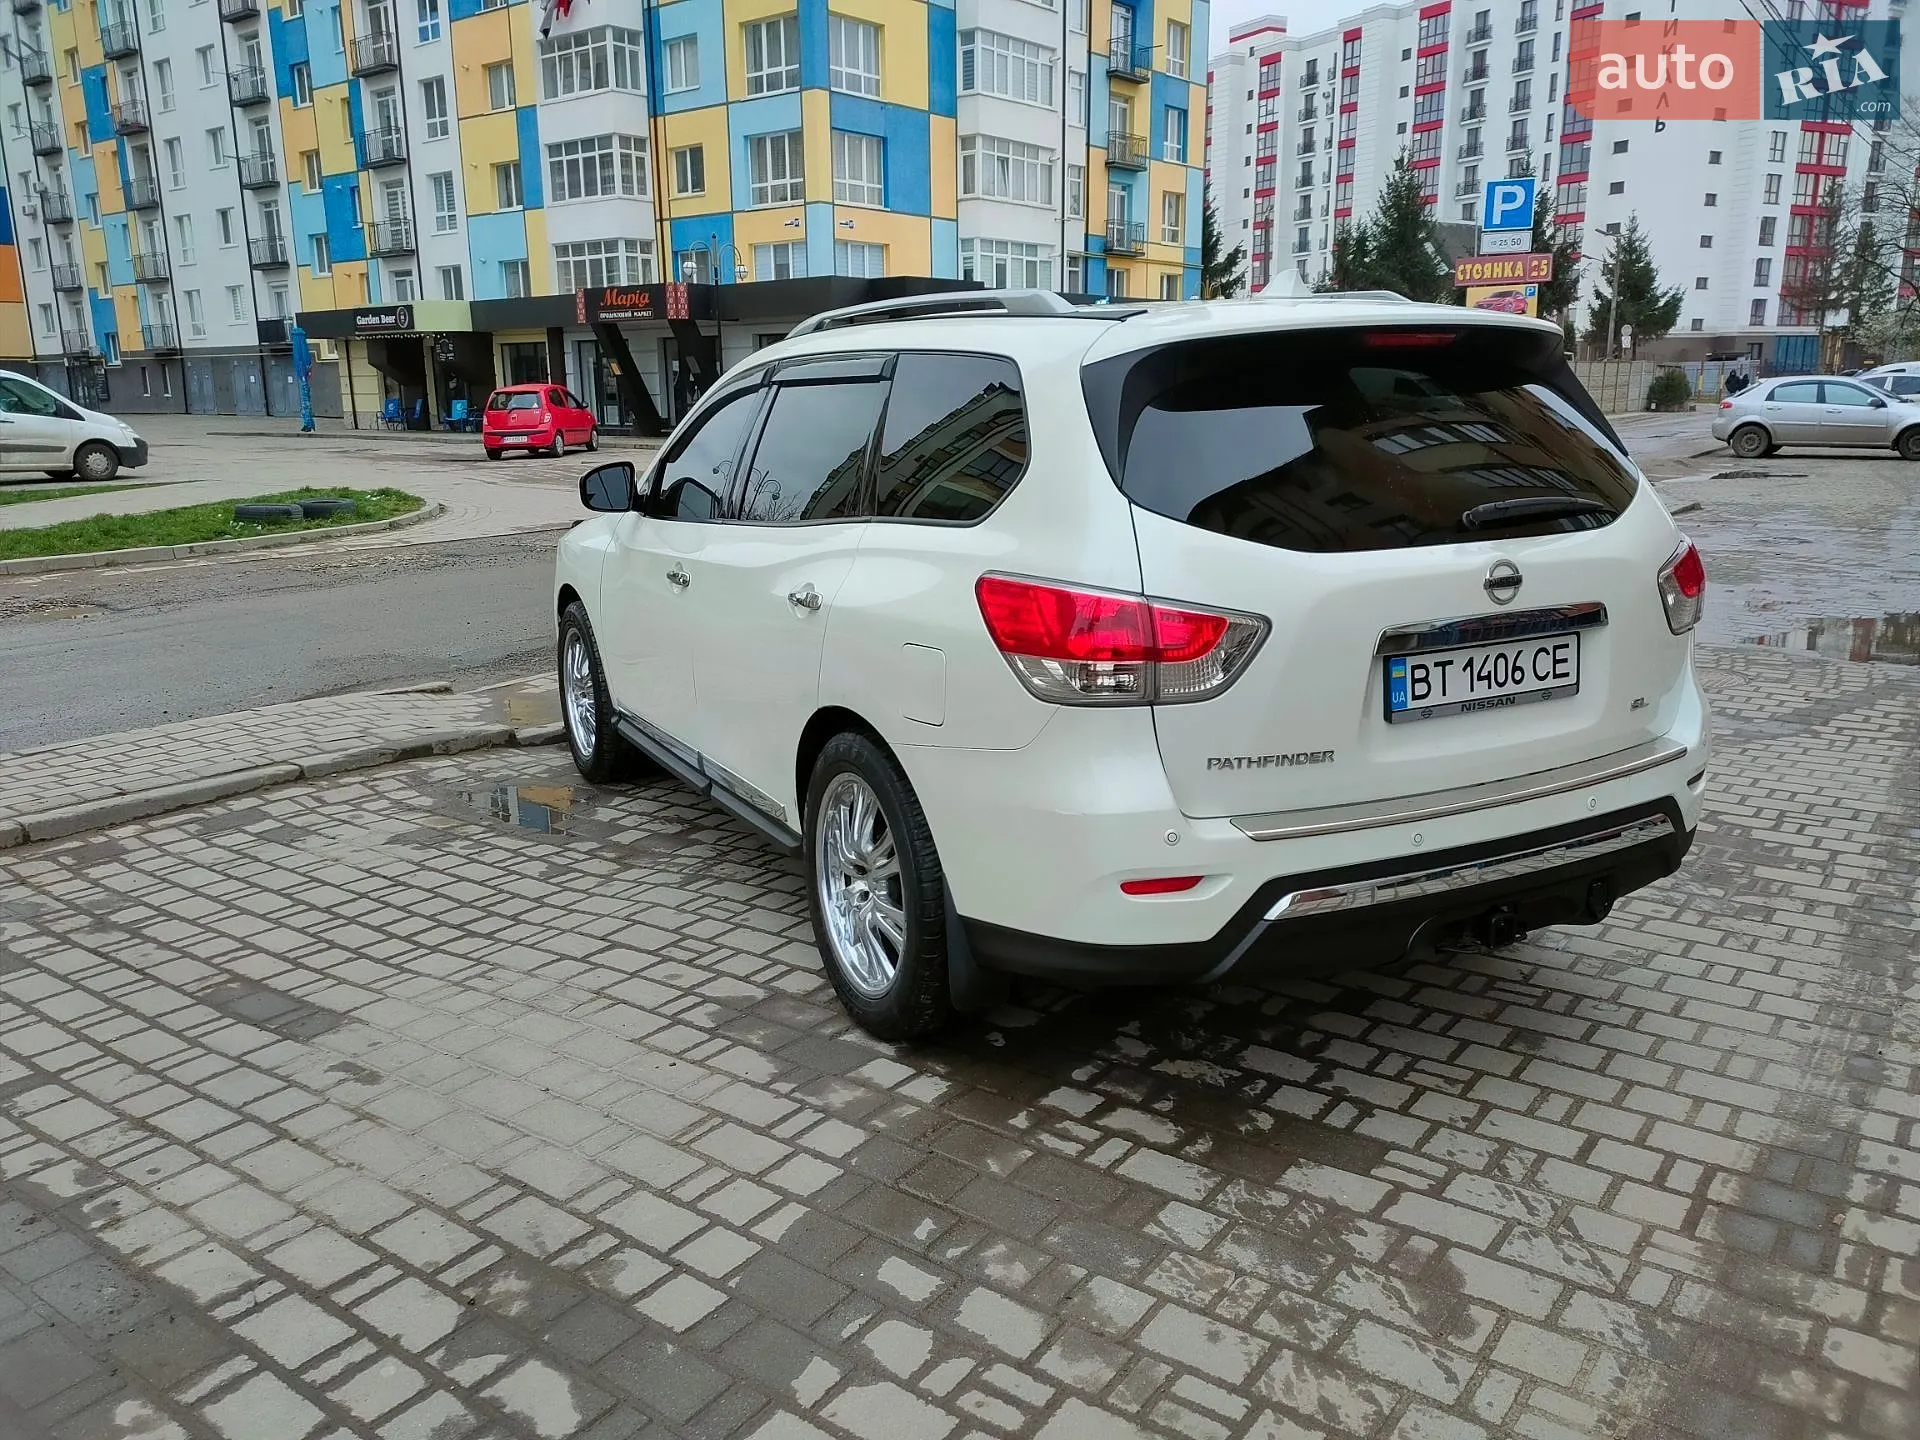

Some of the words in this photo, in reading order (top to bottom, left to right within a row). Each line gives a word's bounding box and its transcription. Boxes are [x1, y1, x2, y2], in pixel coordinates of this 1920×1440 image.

[1493, 185, 1526, 225] P
[1511, 238, 1522, 246] 50
[1457, 261, 1524, 281] СТОЯНКА
[1531, 259, 1548, 278] 25
[356, 314, 380, 325] Garden
[380, 314, 396, 324] Beer
[633, 310, 653, 318] МАРКЕТ
[1410, 660, 1454, 702] BT
[1462, 650, 1526, 693] 1406
[1532, 643, 1570, 682] CE
[1392, 691, 1406, 703] UA
[1460, 697, 1516, 713] NISSAN
[1206, 750, 1335, 770] PATHFINDER
